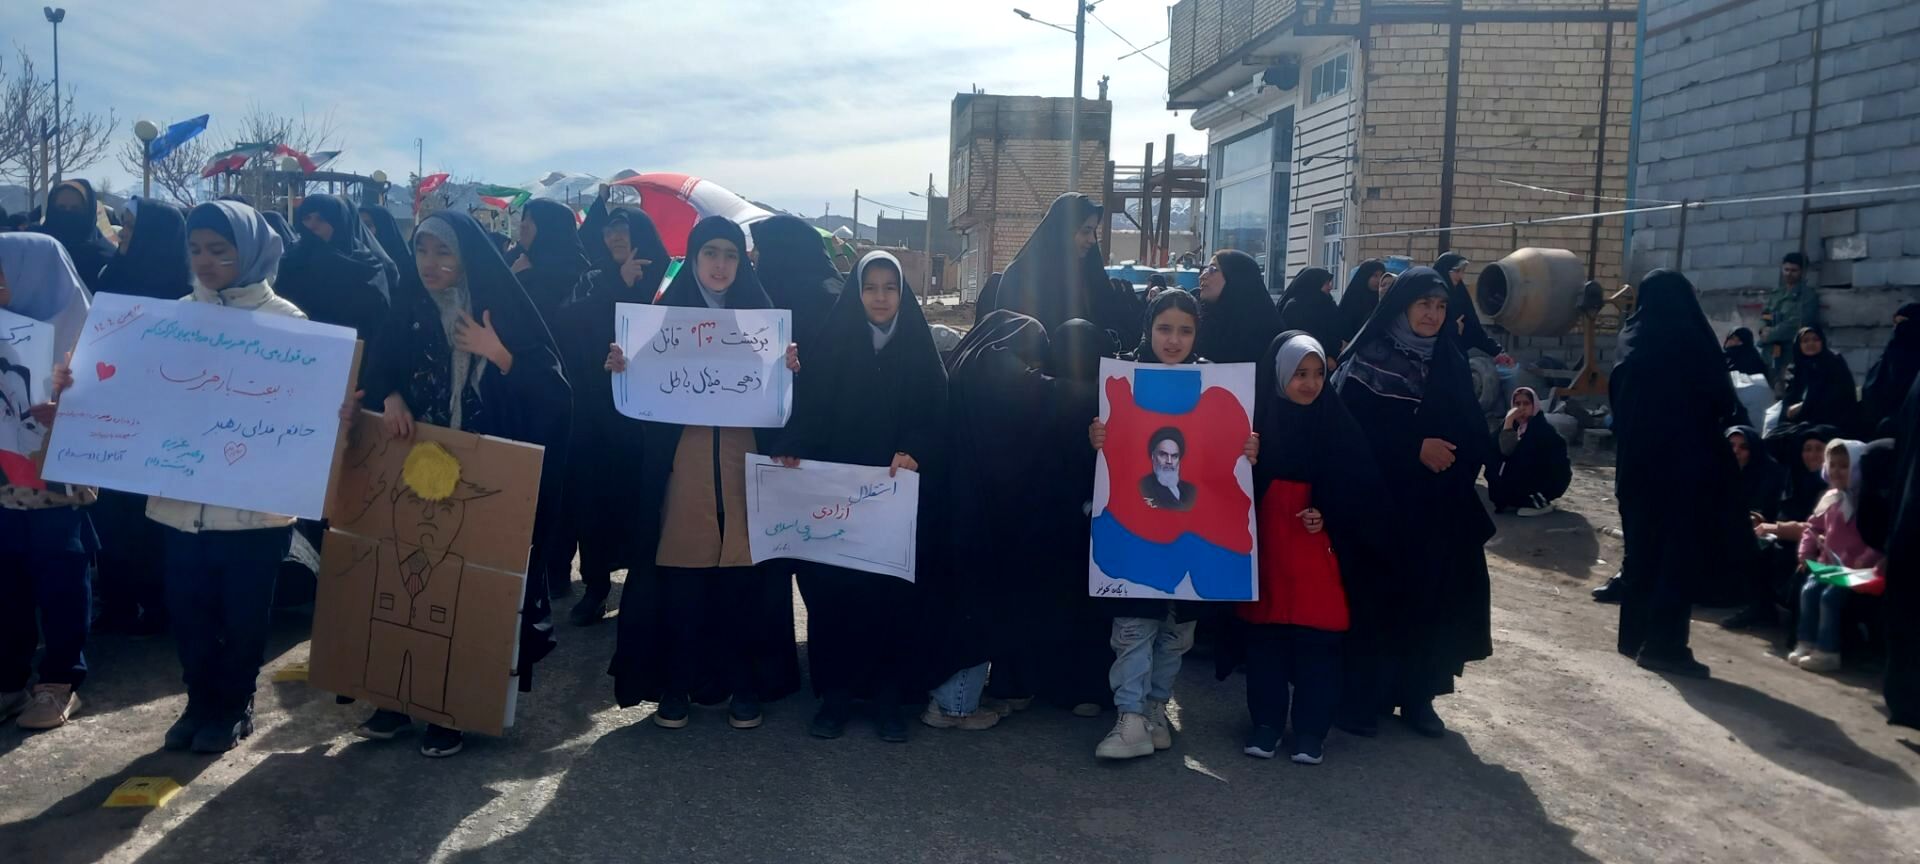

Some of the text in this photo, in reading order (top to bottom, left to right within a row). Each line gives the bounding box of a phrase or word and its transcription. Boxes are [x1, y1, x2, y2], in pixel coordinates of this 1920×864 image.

[244, 339, 260, 355] دهم
[652, 327, 682, 353] قاتل
[260, 348, 278, 360] می
[278, 346, 301, 363] قول
[159, 362, 225, 391] رهبری
[660, 367, 691, 394] باطل
[692, 366, 720, 394] خیال
[233, 380, 281, 404] بیعت
[202, 417, 242, 436] رهبر
[241, 419, 275, 438] فدای
[848, 481, 897, 504] استقلال
[765, 519, 798, 536] اسلامی
